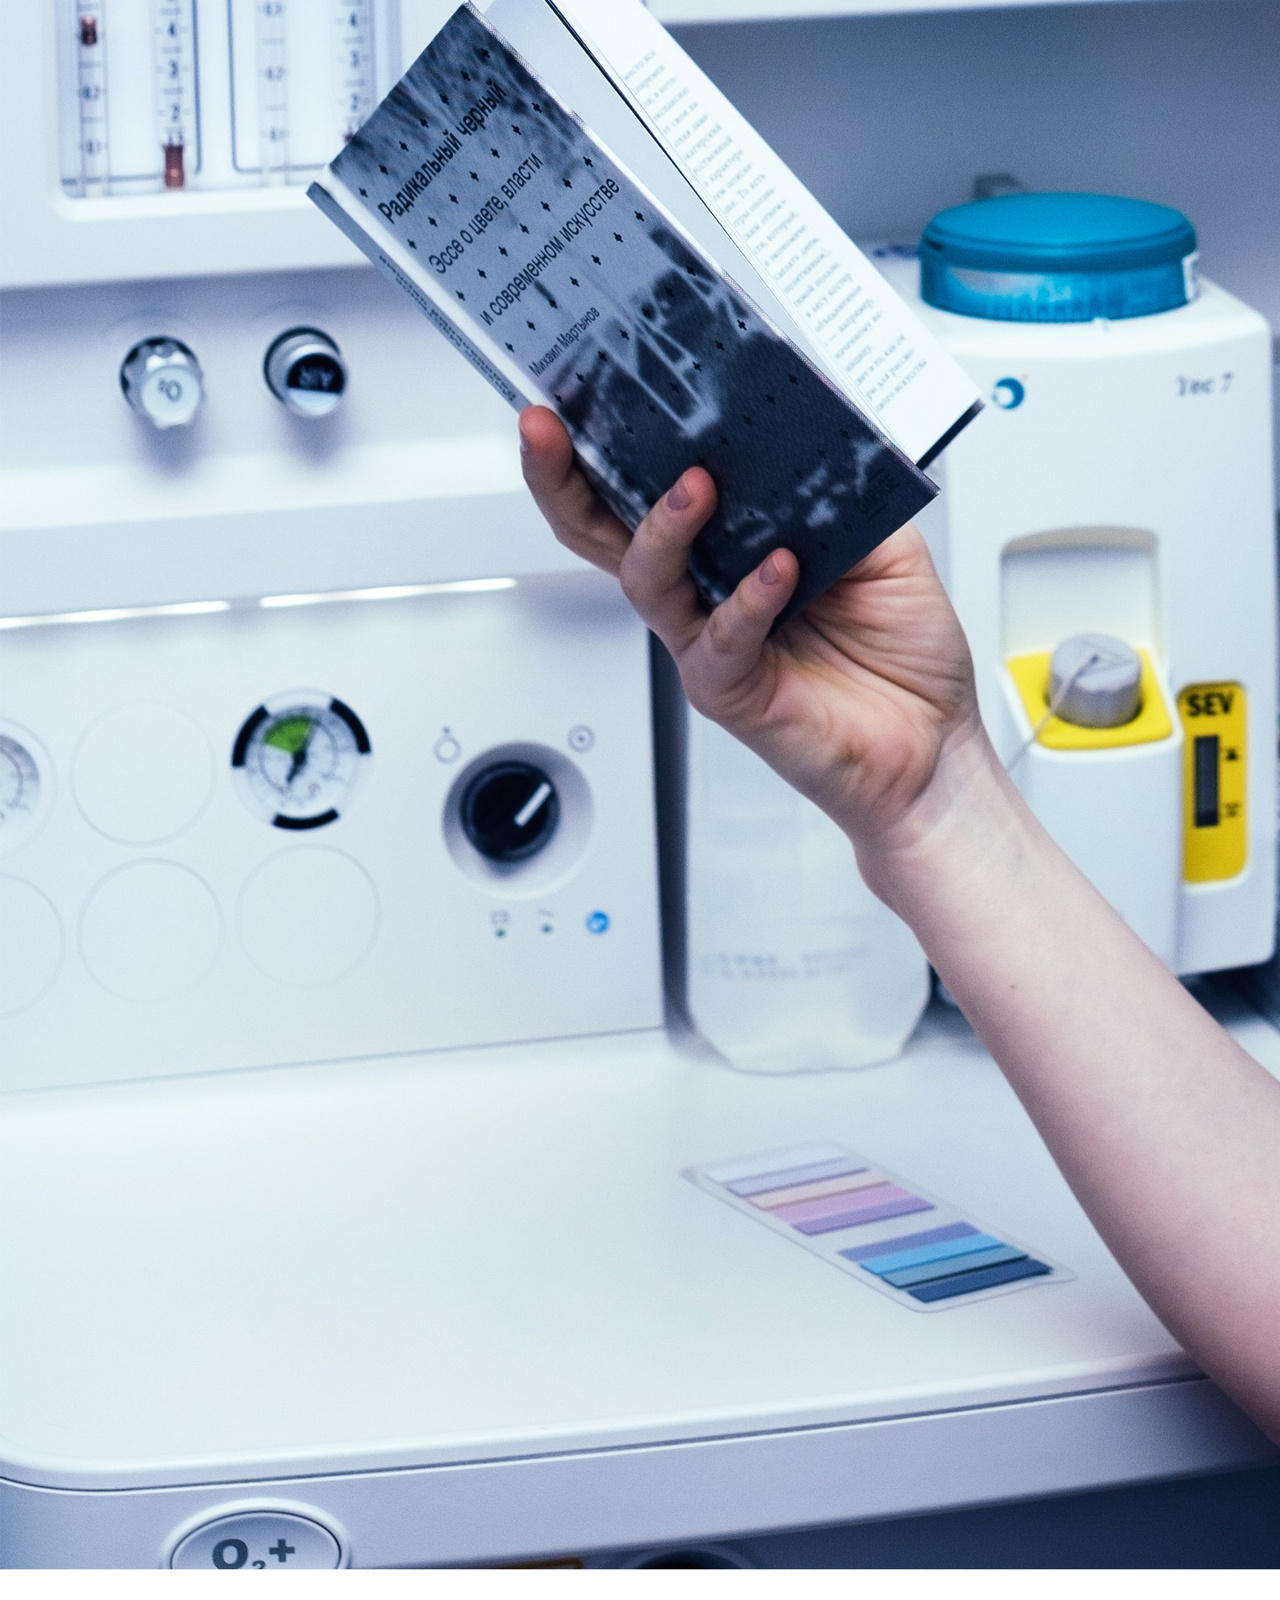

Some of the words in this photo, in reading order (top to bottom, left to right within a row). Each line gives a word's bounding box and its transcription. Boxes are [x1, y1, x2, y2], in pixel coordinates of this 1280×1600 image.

[378, 129, 463, 224] Радикальный
[457, 77, 508, 137] черный
[428, 239, 465, 274] Эссе
[459, 229, 474, 245] о
[468, 195, 510, 235] цвете,
[500, 152, 544, 200] власти
[479, 310, 495, 326] и
[489, 235, 566, 316] современном
[558, 178, 620, 243] искусстве
[528, 343, 563, 377] Михаил
[555, 306, 600, 350] Мартынов
[1187, 691, 1234, 716] SEV
